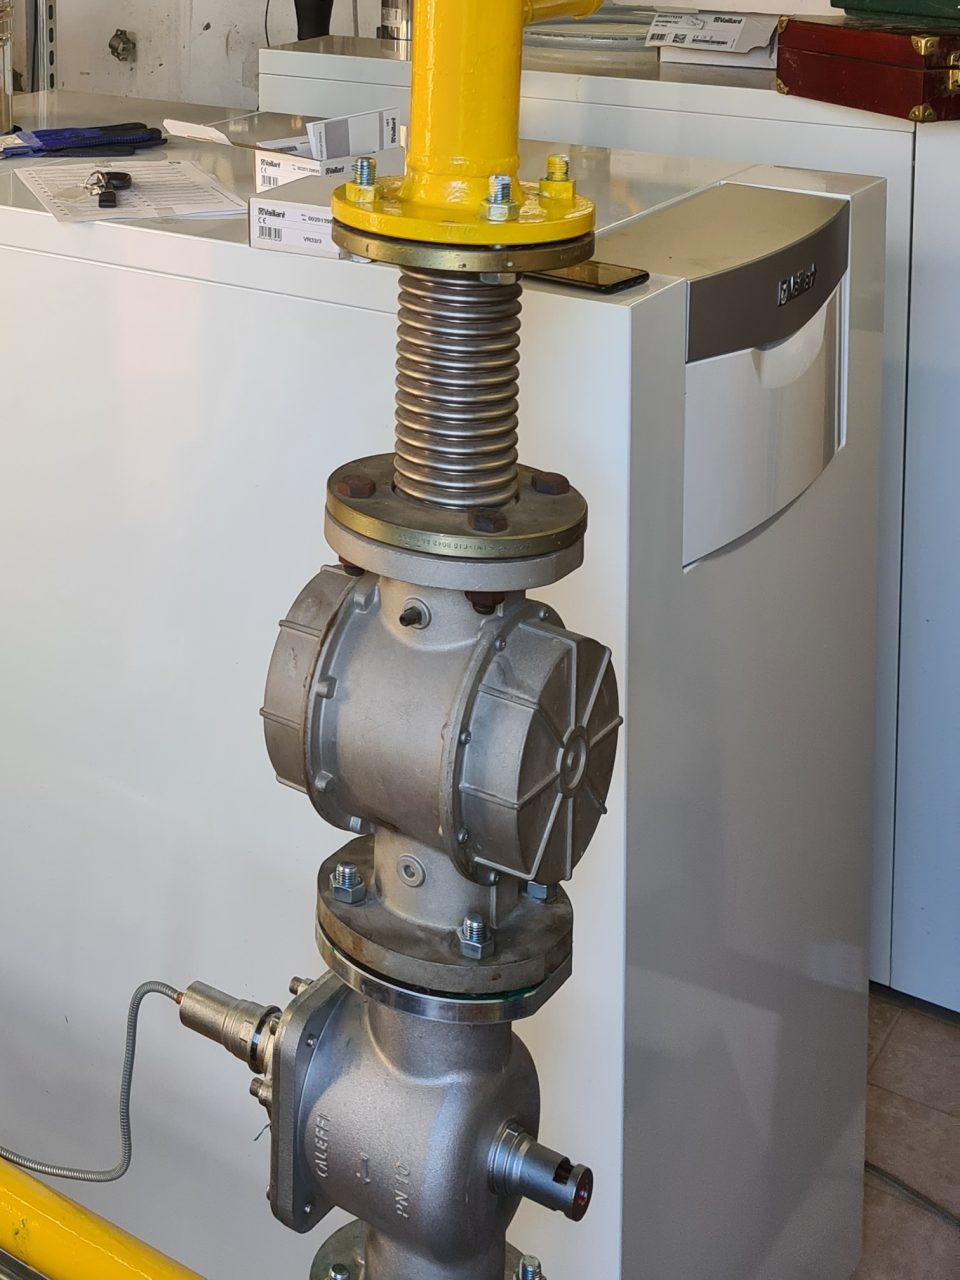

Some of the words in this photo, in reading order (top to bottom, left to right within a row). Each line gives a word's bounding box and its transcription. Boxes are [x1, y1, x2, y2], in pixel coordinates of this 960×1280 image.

[721, 17, 743, 25] Vaillant
[264, 160, 281, 168] Vaillant
[329, 165, 345, 174] Vaillant
[264, 209, 286, 219] Vaillant
[315, 1111, 331, 1178] CALEFFI
